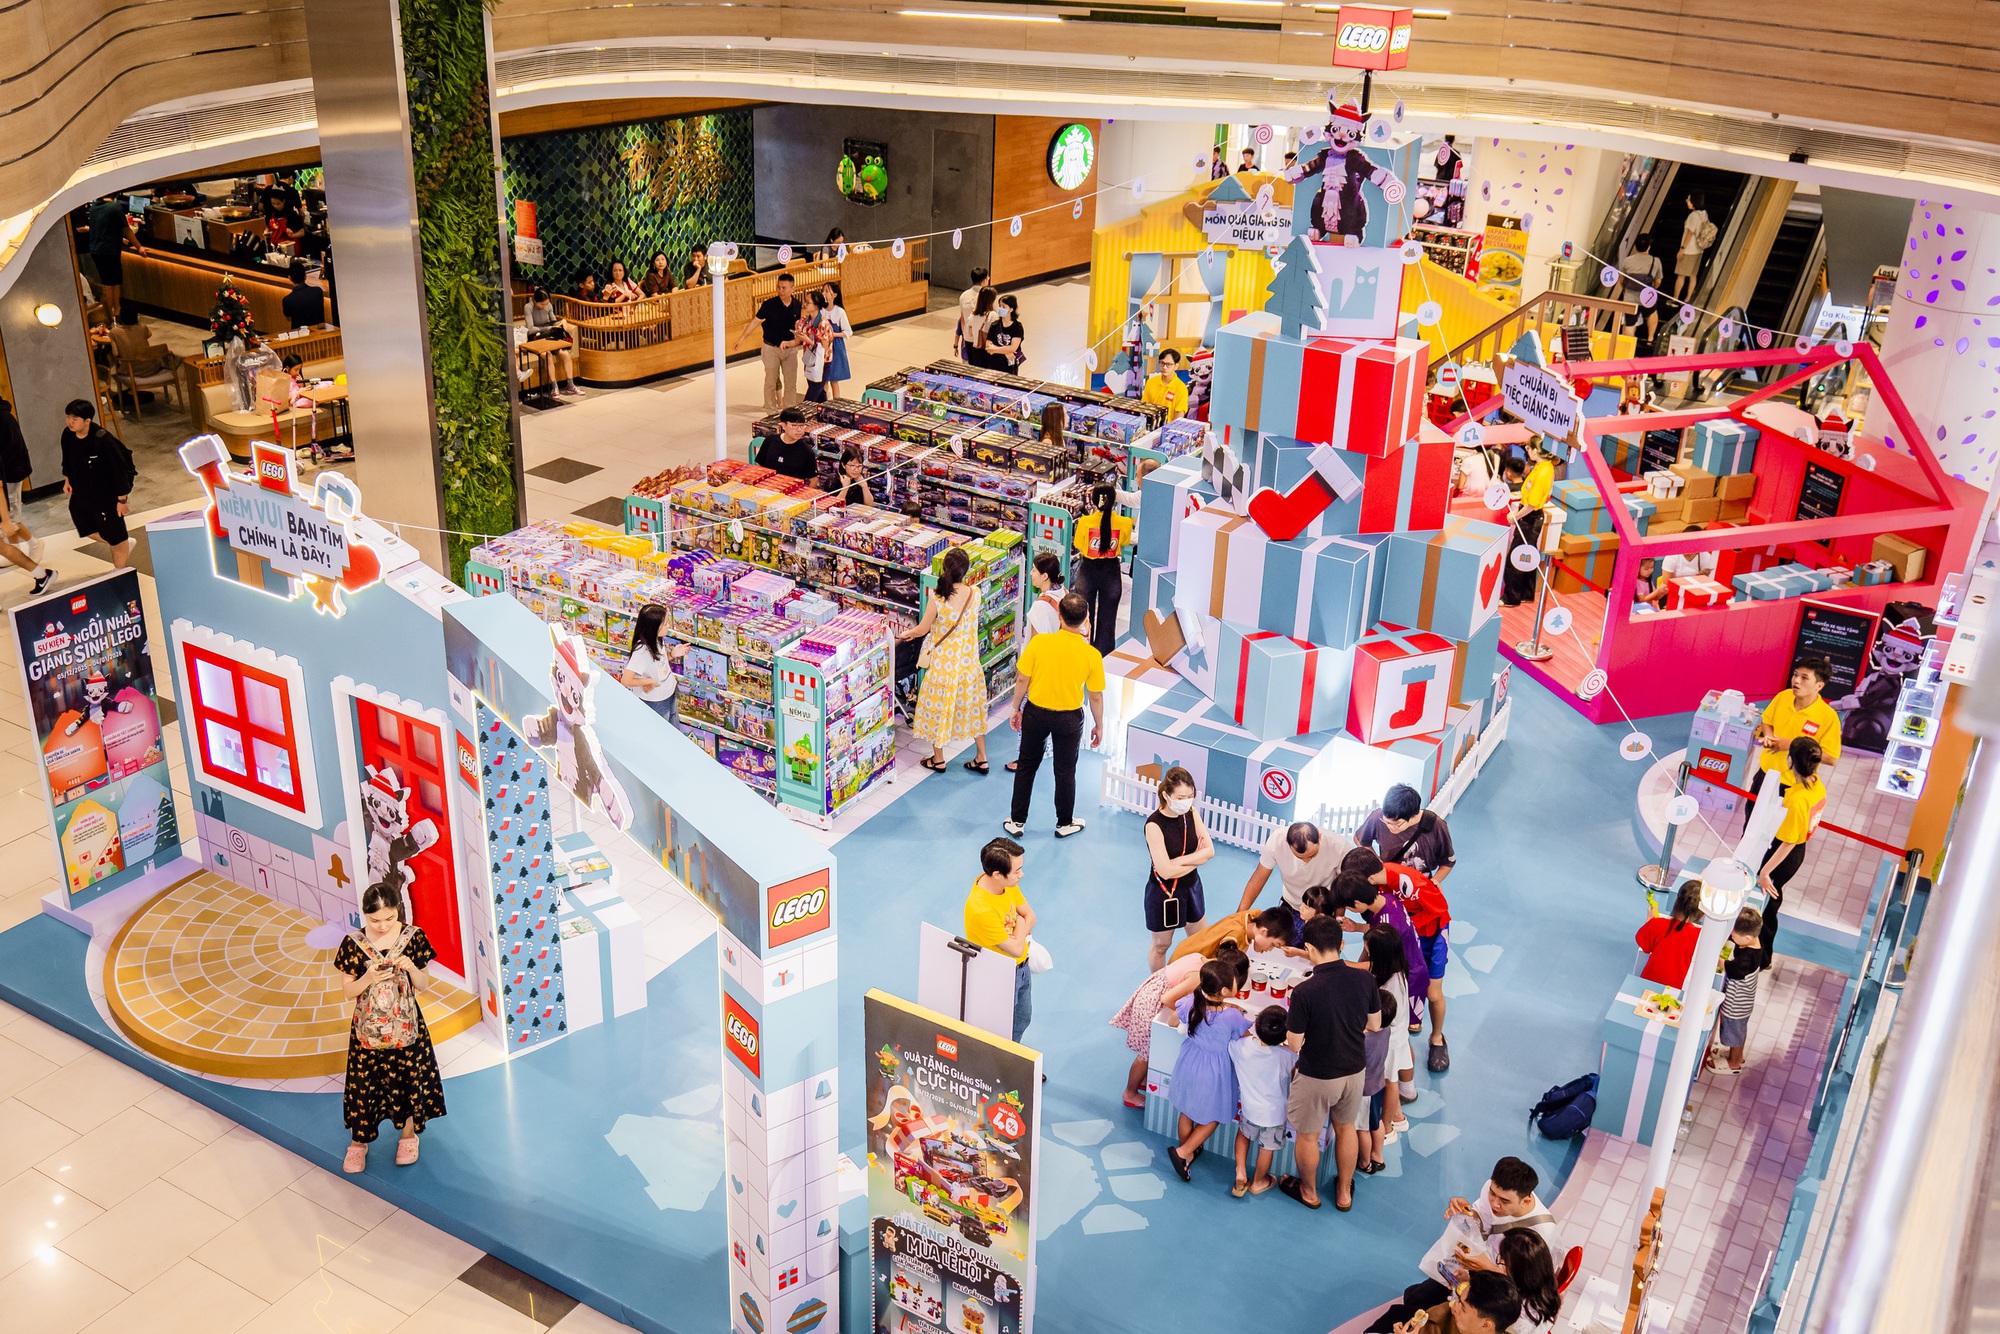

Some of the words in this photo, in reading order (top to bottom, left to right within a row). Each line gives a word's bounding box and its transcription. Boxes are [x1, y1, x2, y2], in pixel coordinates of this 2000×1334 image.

[1338, 24, 1388, 52] LEGO
[1232, 227, 1256, 242] DIỆU
[1486, 234, 1510, 242] NOODLE
[1487, 228, 1518, 238] JAPANESE
[1502, 218, 1514, 229] 4F
[1484, 240, 1524, 250] RESTAURANT
[1505, 384, 1522, 406] TIỆC
[1522, 394, 1548, 420] GIÁNG
[1549, 408, 1570, 426] SINH
[1520, 373, 1550, 398] CHUẨN
[1549, 389, 1558, 406] BỊ
[260, 460, 286, 482] LEGO
[220, 490, 252, 521] NIỀM
[254, 499, 284, 530] VUI
[286, 511, 318, 543] BẠN
[320, 522, 344, 550] TÌM
[238, 522, 278, 550] CHÍNH
[282, 536, 299, 560] LÀ
[301, 544, 332, 569] ĐÂY!
[50, 636, 66, 650] KIỆN
[74, 618, 104, 645] NGÔI
[106, 611, 132, 632] NHÀ
[28, 650, 72, 681] GIÁNG
[74, 636, 110, 664] SINH
[111, 624, 142, 648] LEGO
[56, 662, 88, 680] 05/12/2025
[460, 746, 478, 778] LEGO
[1700, 756, 1728, 772] LEGO
[772, 888, 826, 928] LEGO
[727, 1014, 758, 1056] LEGO
[904, 1051, 921, 1064] QUÀ
[922, 1054, 950, 1076] TẶNG
[950, 1067, 974, 1086] GIÁNG
[916, 1066, 947, 1091] CỰC
[950, 1080, 980, 1107] HOT
[893, 1215, 913, 1230] QUÀ
[914, 1222, 946, 1246] TẶNG
[969, 1248, 1000, 1270] QUYỀN
